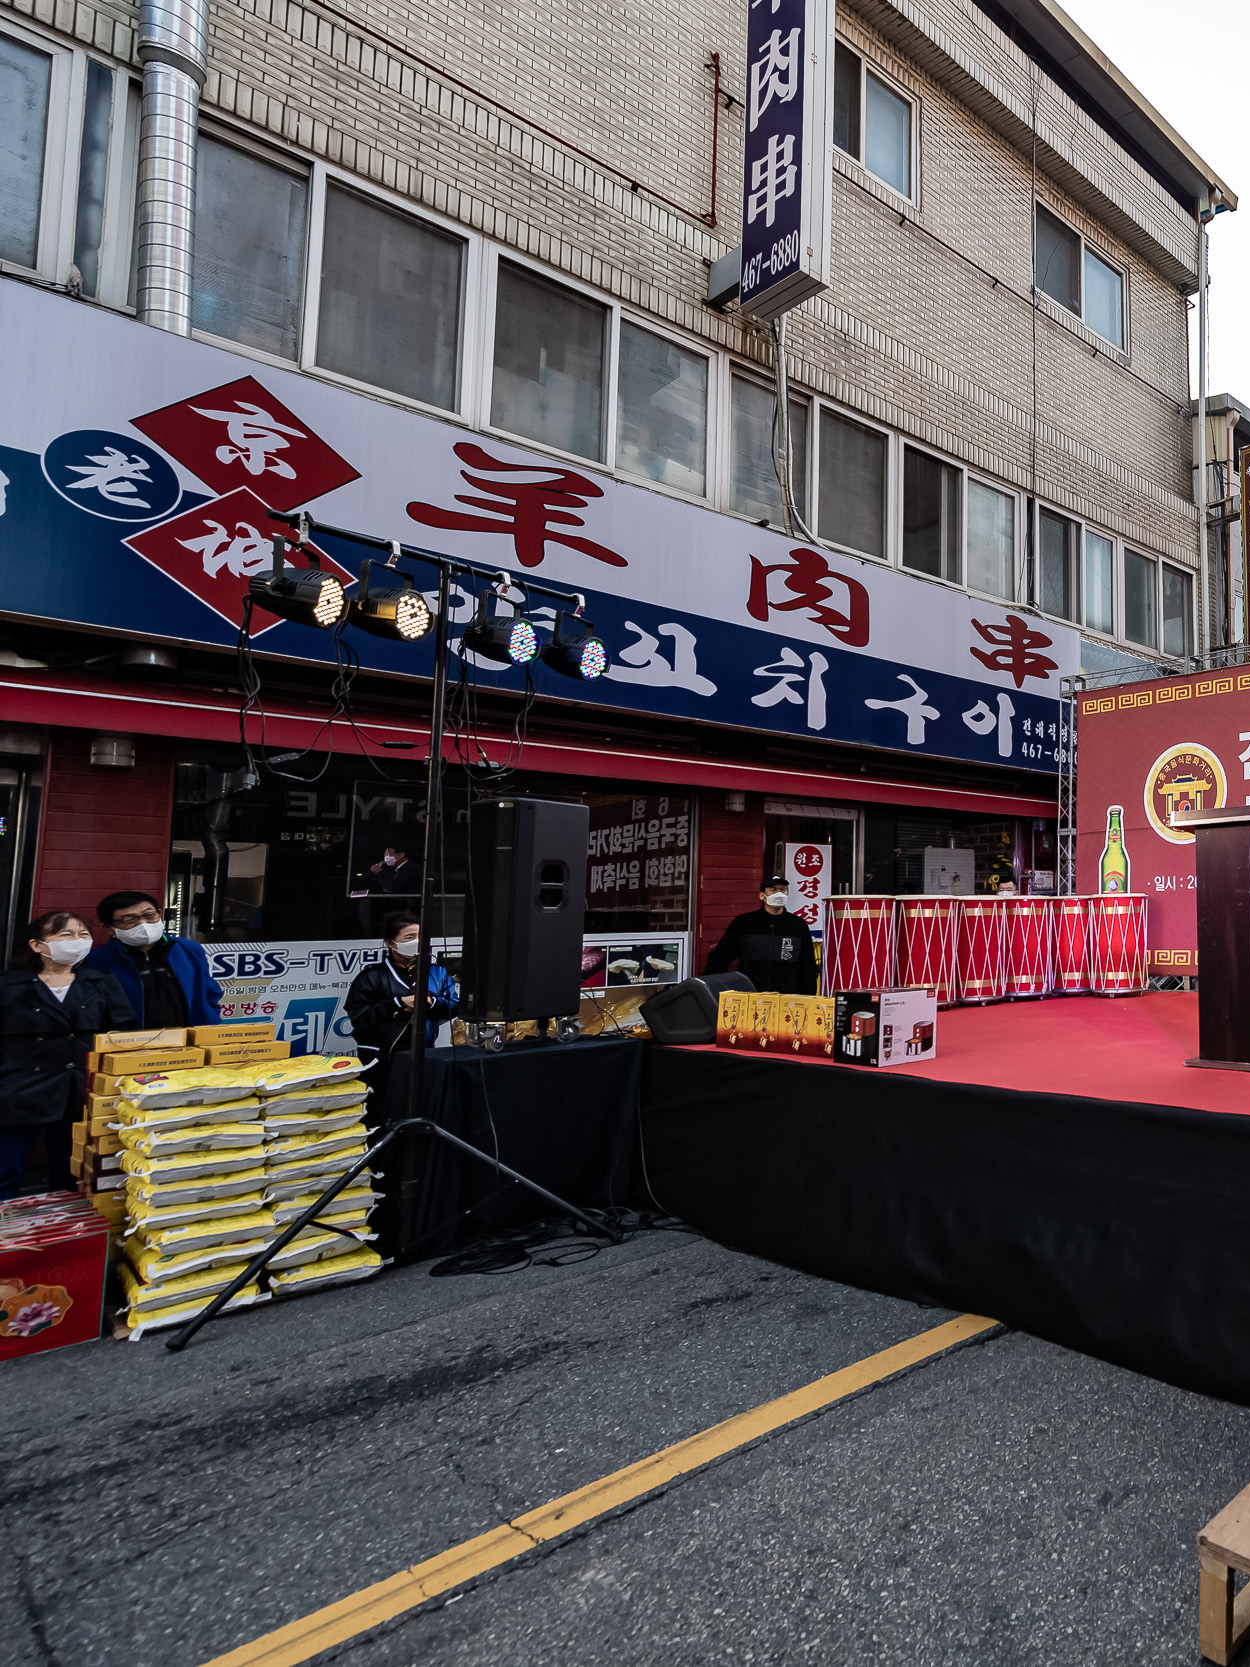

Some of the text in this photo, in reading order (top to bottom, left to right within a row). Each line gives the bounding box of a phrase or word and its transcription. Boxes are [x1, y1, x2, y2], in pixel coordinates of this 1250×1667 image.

[742, 229, 799, 293] 467-6880
[1158, 754, 1213, 782] 중국음식문화거리
[795, 852, 821, 868] 원조
[1154, 875, 1176, 892] 일시
